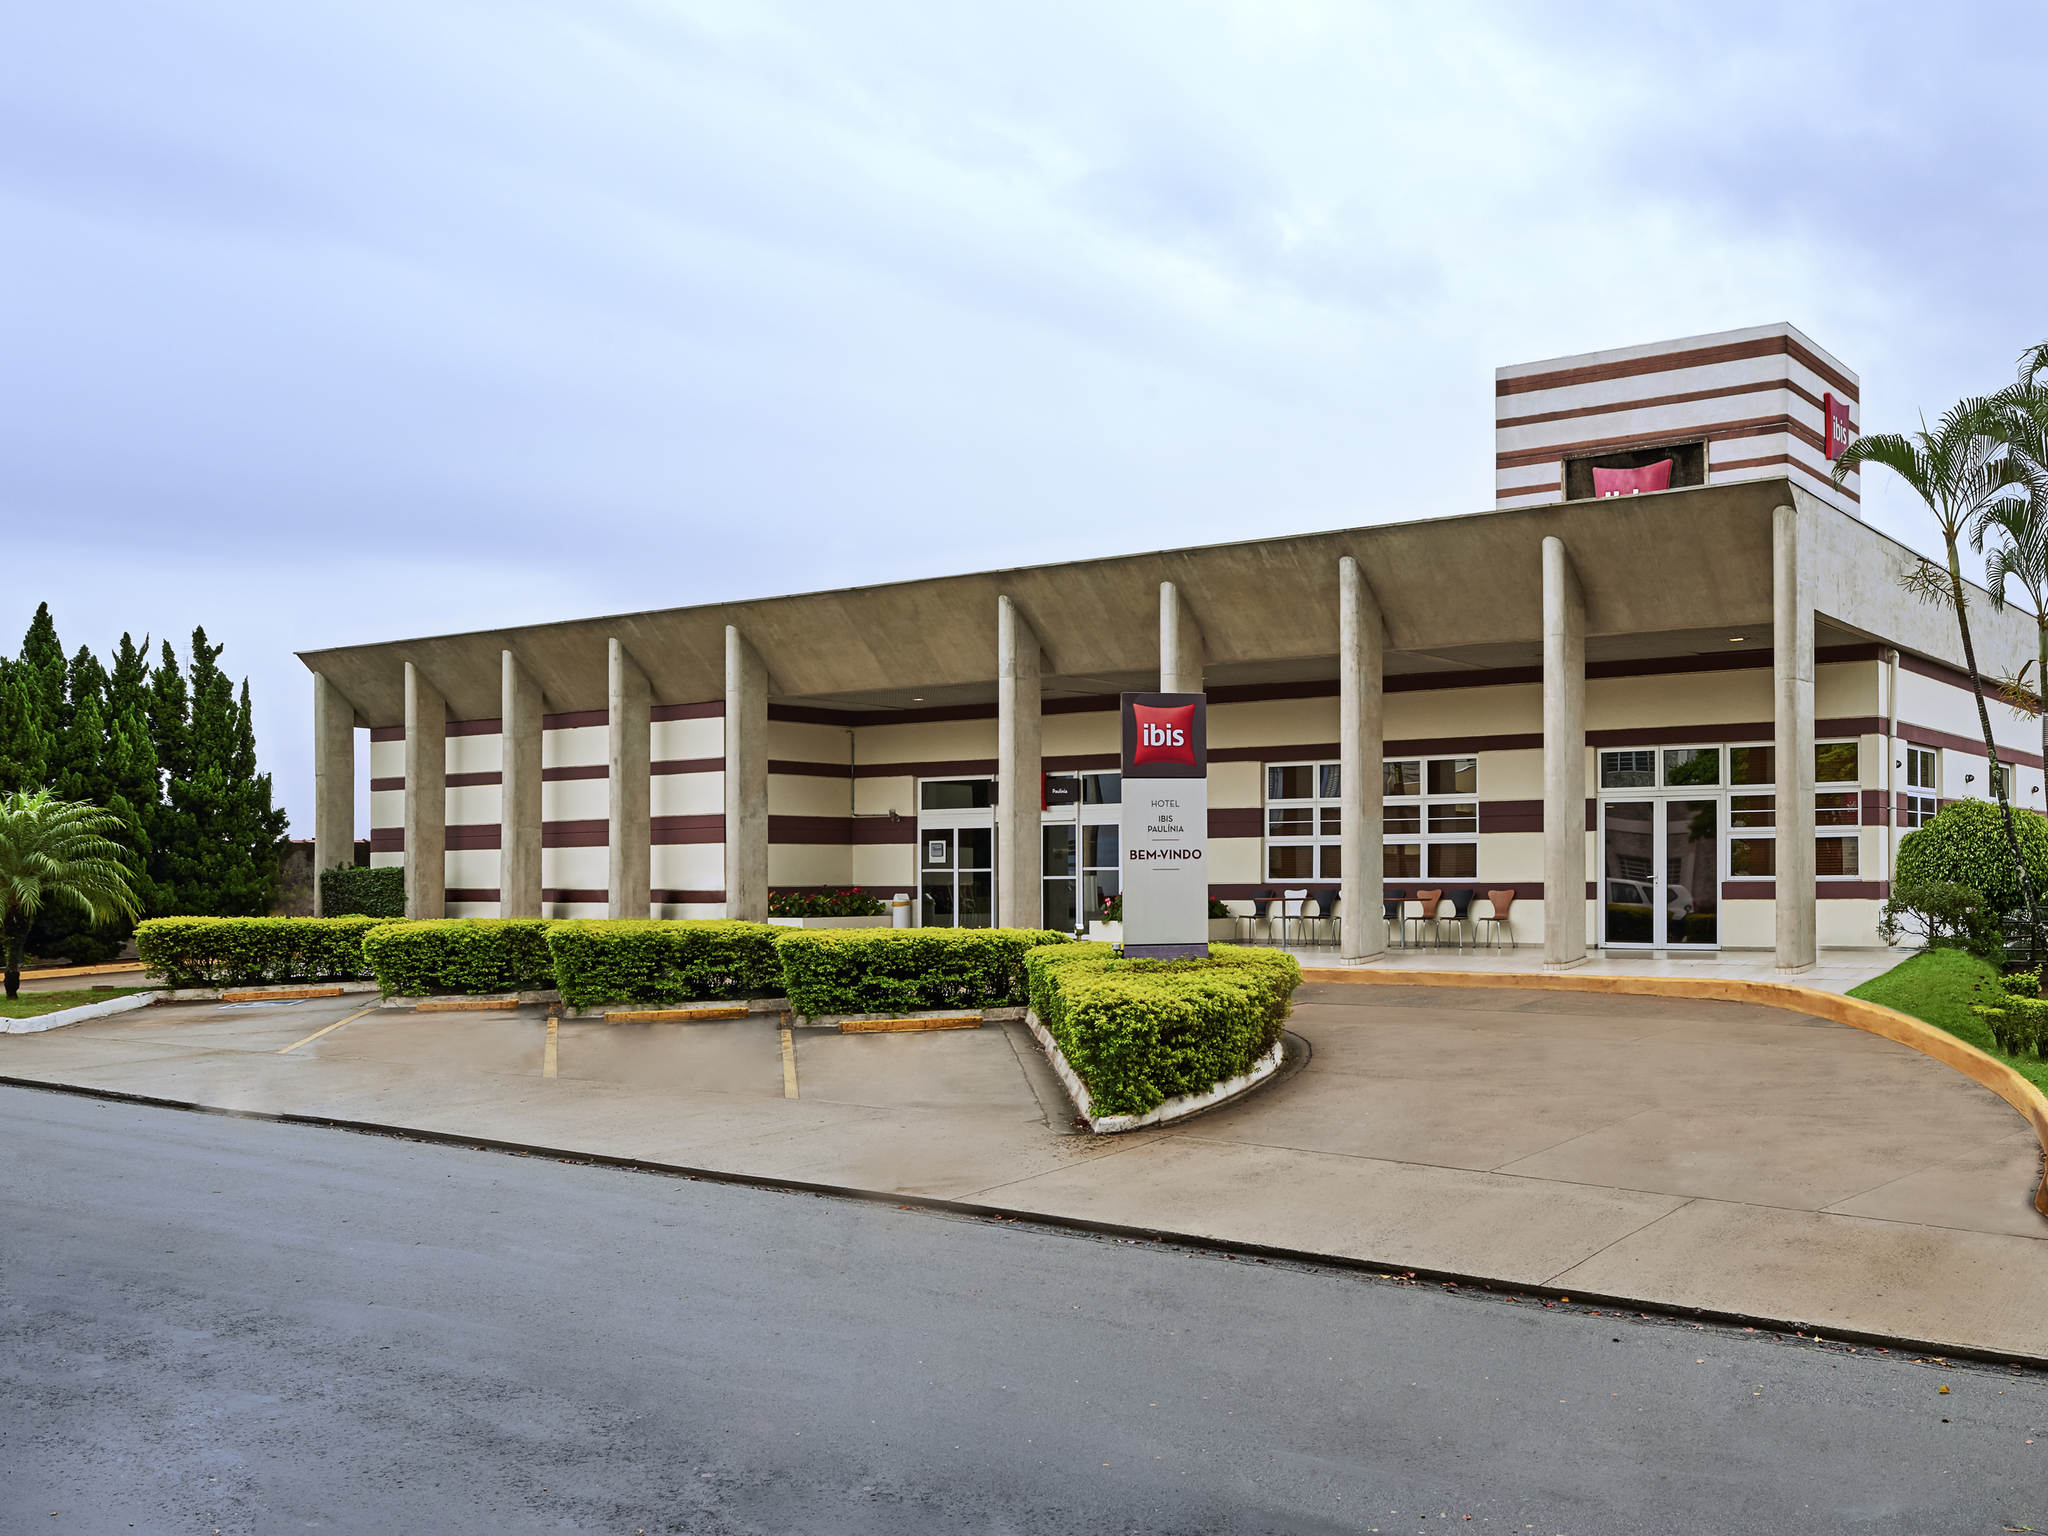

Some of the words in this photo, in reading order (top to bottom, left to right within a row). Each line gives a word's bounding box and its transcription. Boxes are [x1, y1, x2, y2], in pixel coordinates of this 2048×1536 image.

[1832, 415, 1847, 445] ibis
[1143, 723, 1184, 747] ibis
[1151, 799, 1180, 808] HOTEL
[1158, 815, 1173, 823] IBIS
[1147, 824, 1184, 833] PAULÍNIA
[1129, 849, 1202, 860] BEM-VINDO
